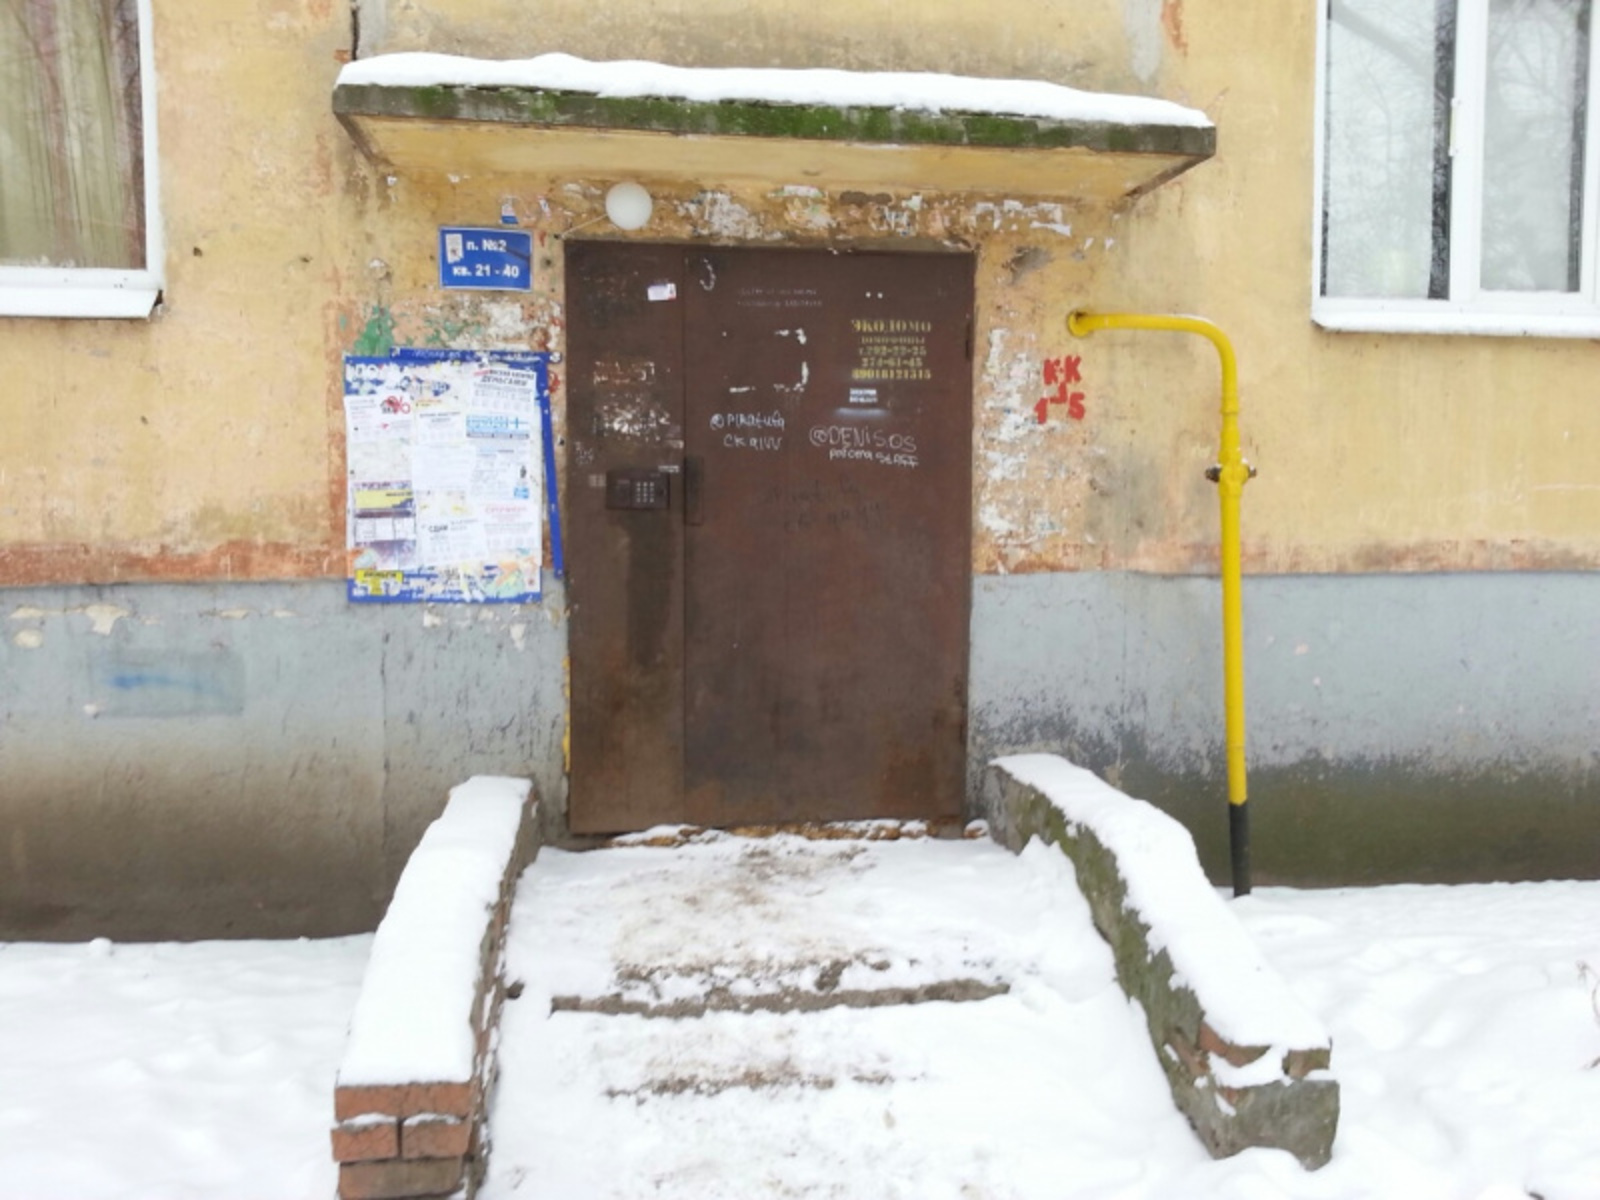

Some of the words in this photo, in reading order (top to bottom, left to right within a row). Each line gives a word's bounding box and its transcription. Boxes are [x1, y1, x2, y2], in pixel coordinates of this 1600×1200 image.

[452, 265, 472, 276] кв.
[475, 264, 491, 276] 21
[502, 264, 519, 278] 40
